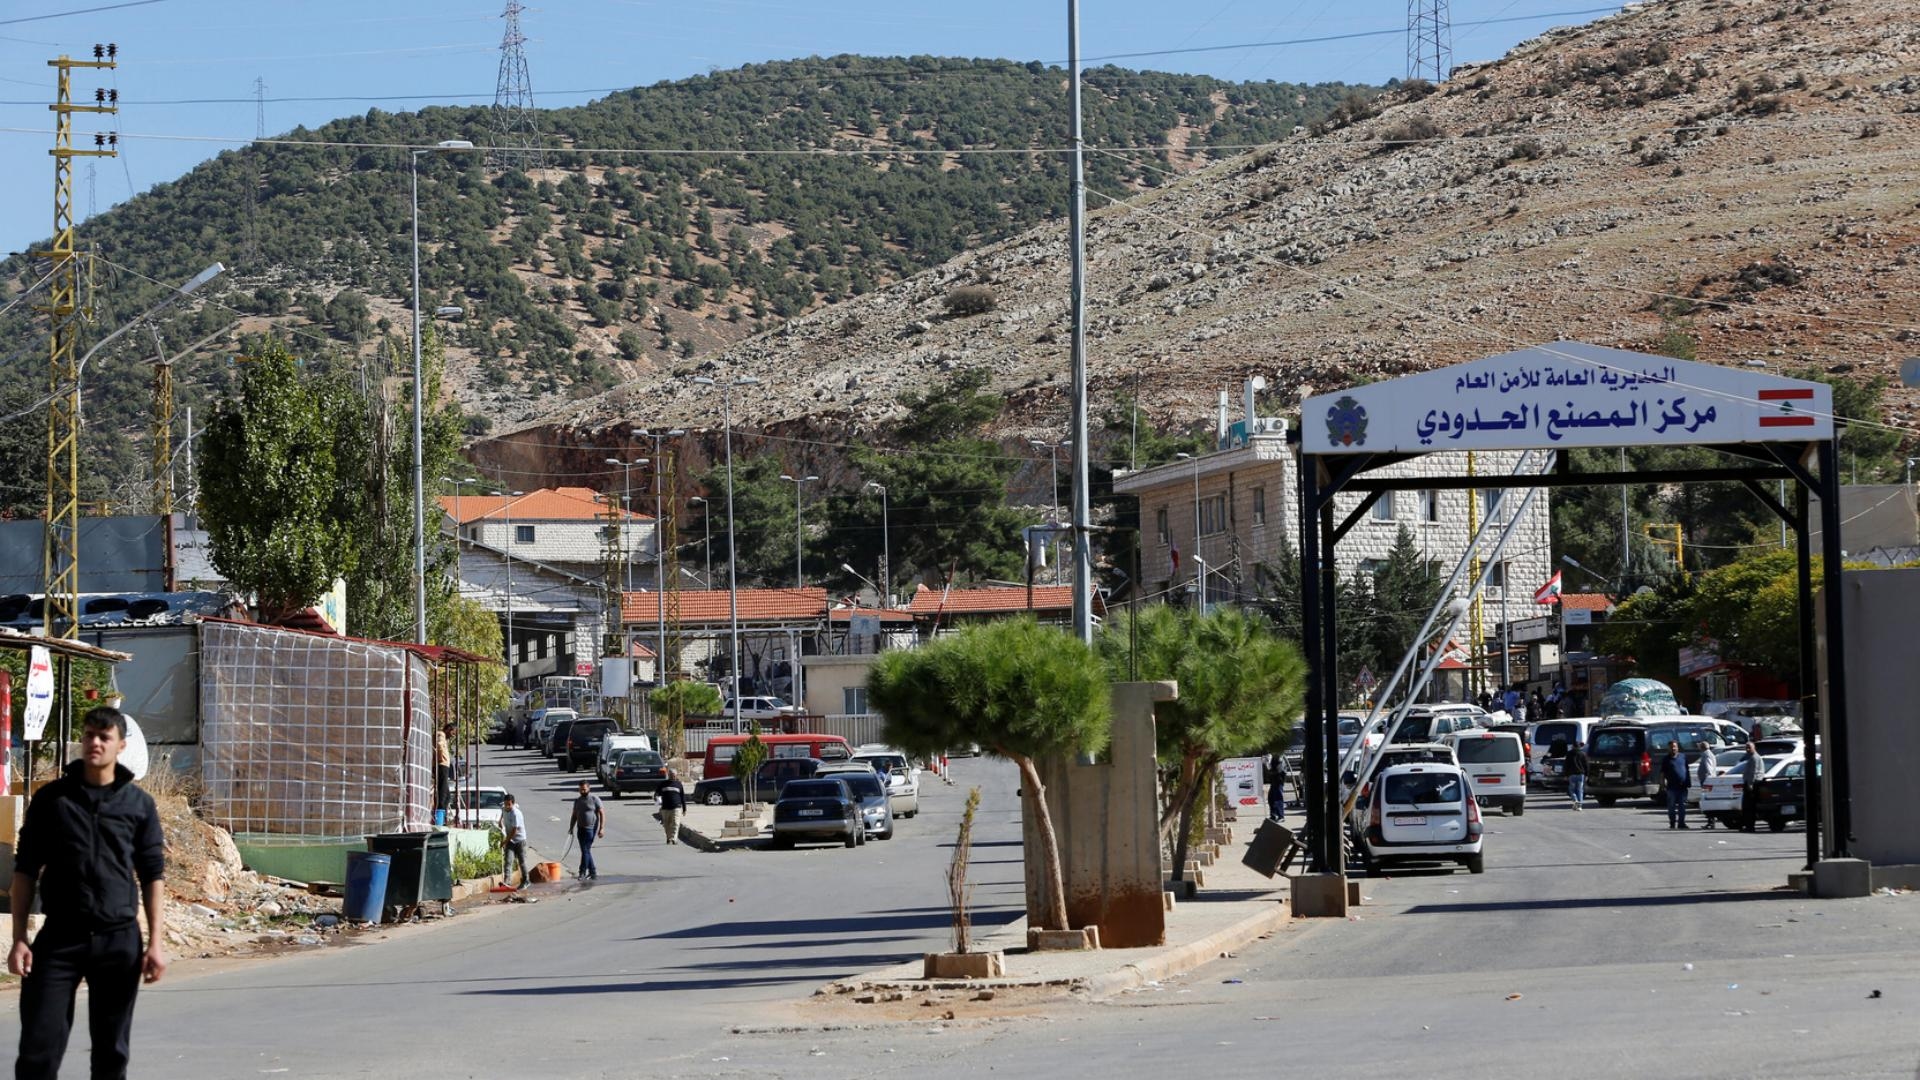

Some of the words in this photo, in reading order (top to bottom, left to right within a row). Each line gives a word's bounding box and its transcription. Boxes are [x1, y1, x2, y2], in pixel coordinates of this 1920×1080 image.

[1455, 371, 1495, 393] العام
[1500, 367, 1541, 393] للأمن
[1546, 367, 1595, 387] العامة
[1599, 365, 1675, 391] المديرية
[1417, 402, 1539, 445] الحدودي
[1546, 399, 1648, 441] المصنع
[1653, 397, 1717, 434] مركز
